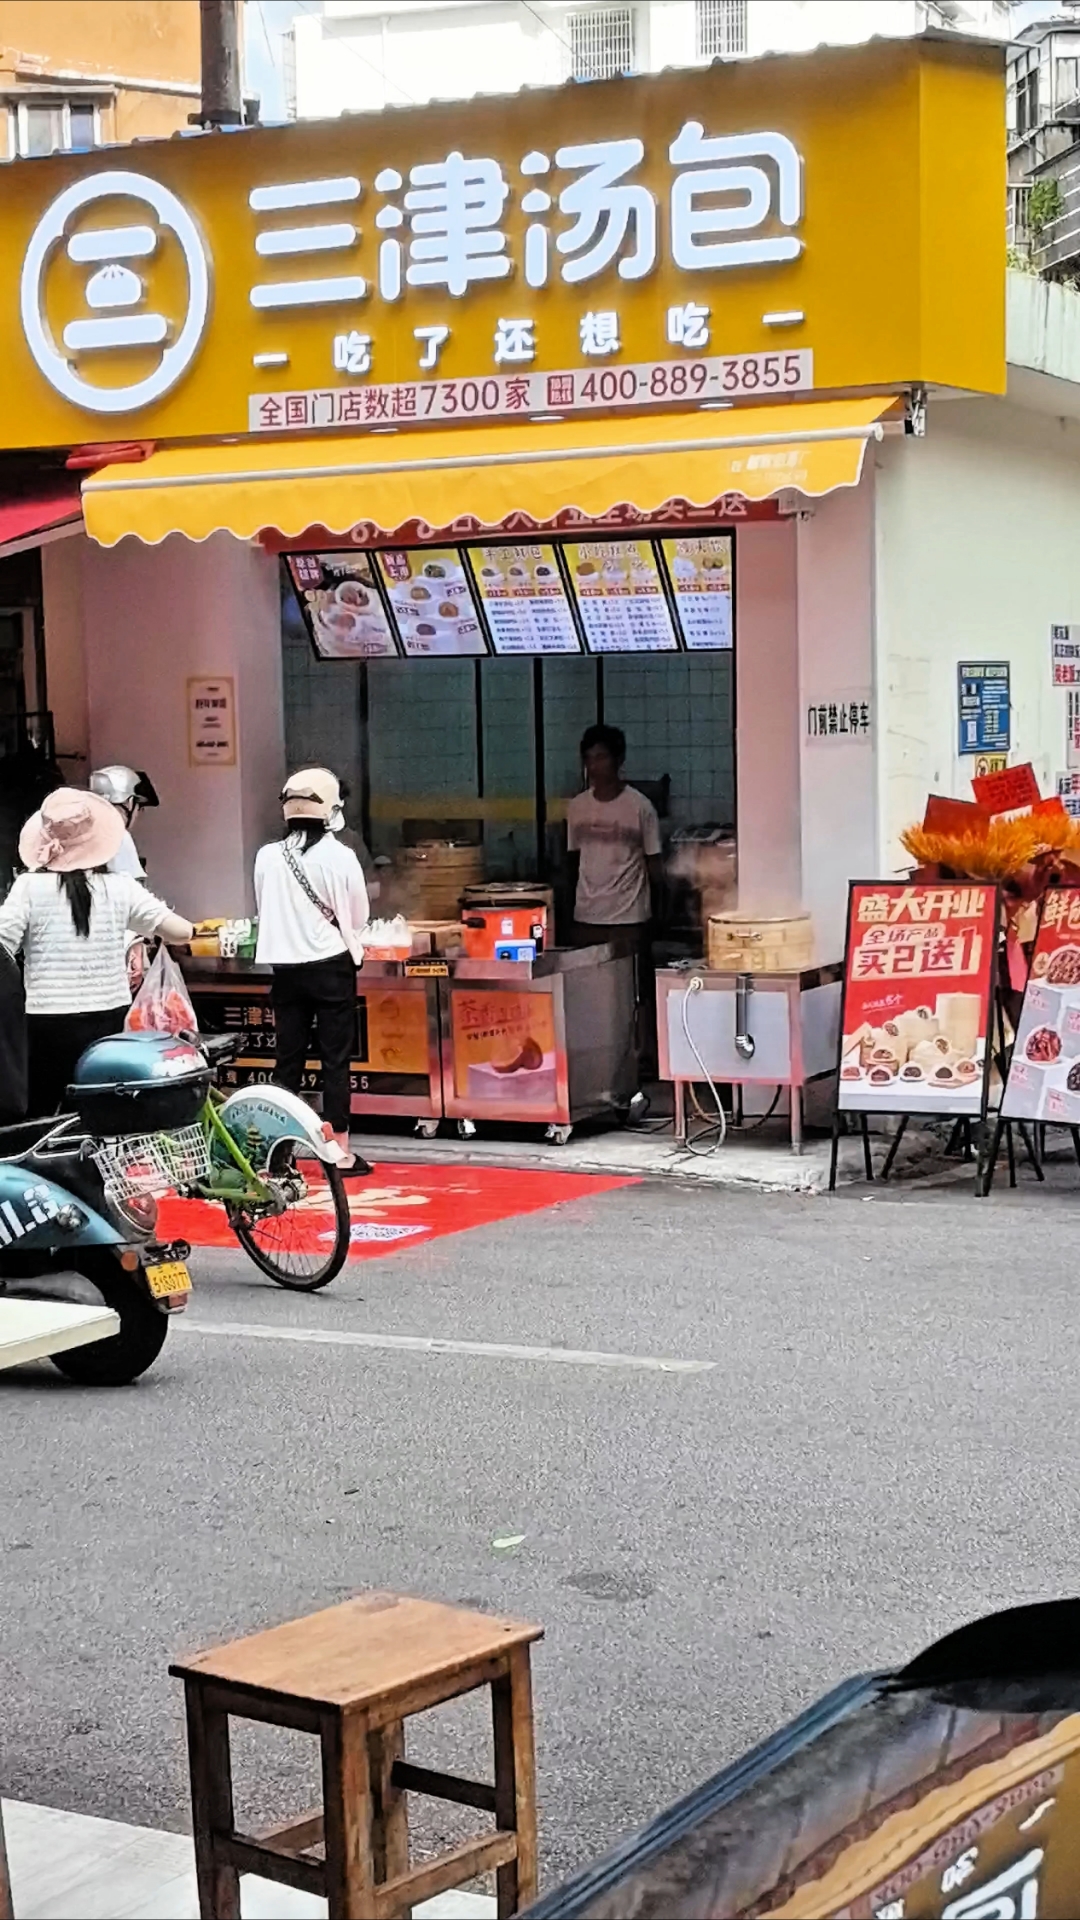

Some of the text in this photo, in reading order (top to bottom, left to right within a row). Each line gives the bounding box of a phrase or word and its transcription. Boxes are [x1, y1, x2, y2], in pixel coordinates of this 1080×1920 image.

[248, 121, 803, 307] 三津汤包
[259, 377, 531, 427] 全国门店数超7300家
[580, 354, 802, 403] 400-889-3855
[807, 701, 869, 736] 门前禁止停车
[857, 887, 986, 922] 盛大开业
[857, 928, 978, 976] 买2送1
[865, 927, 939, 945] 全场产品
